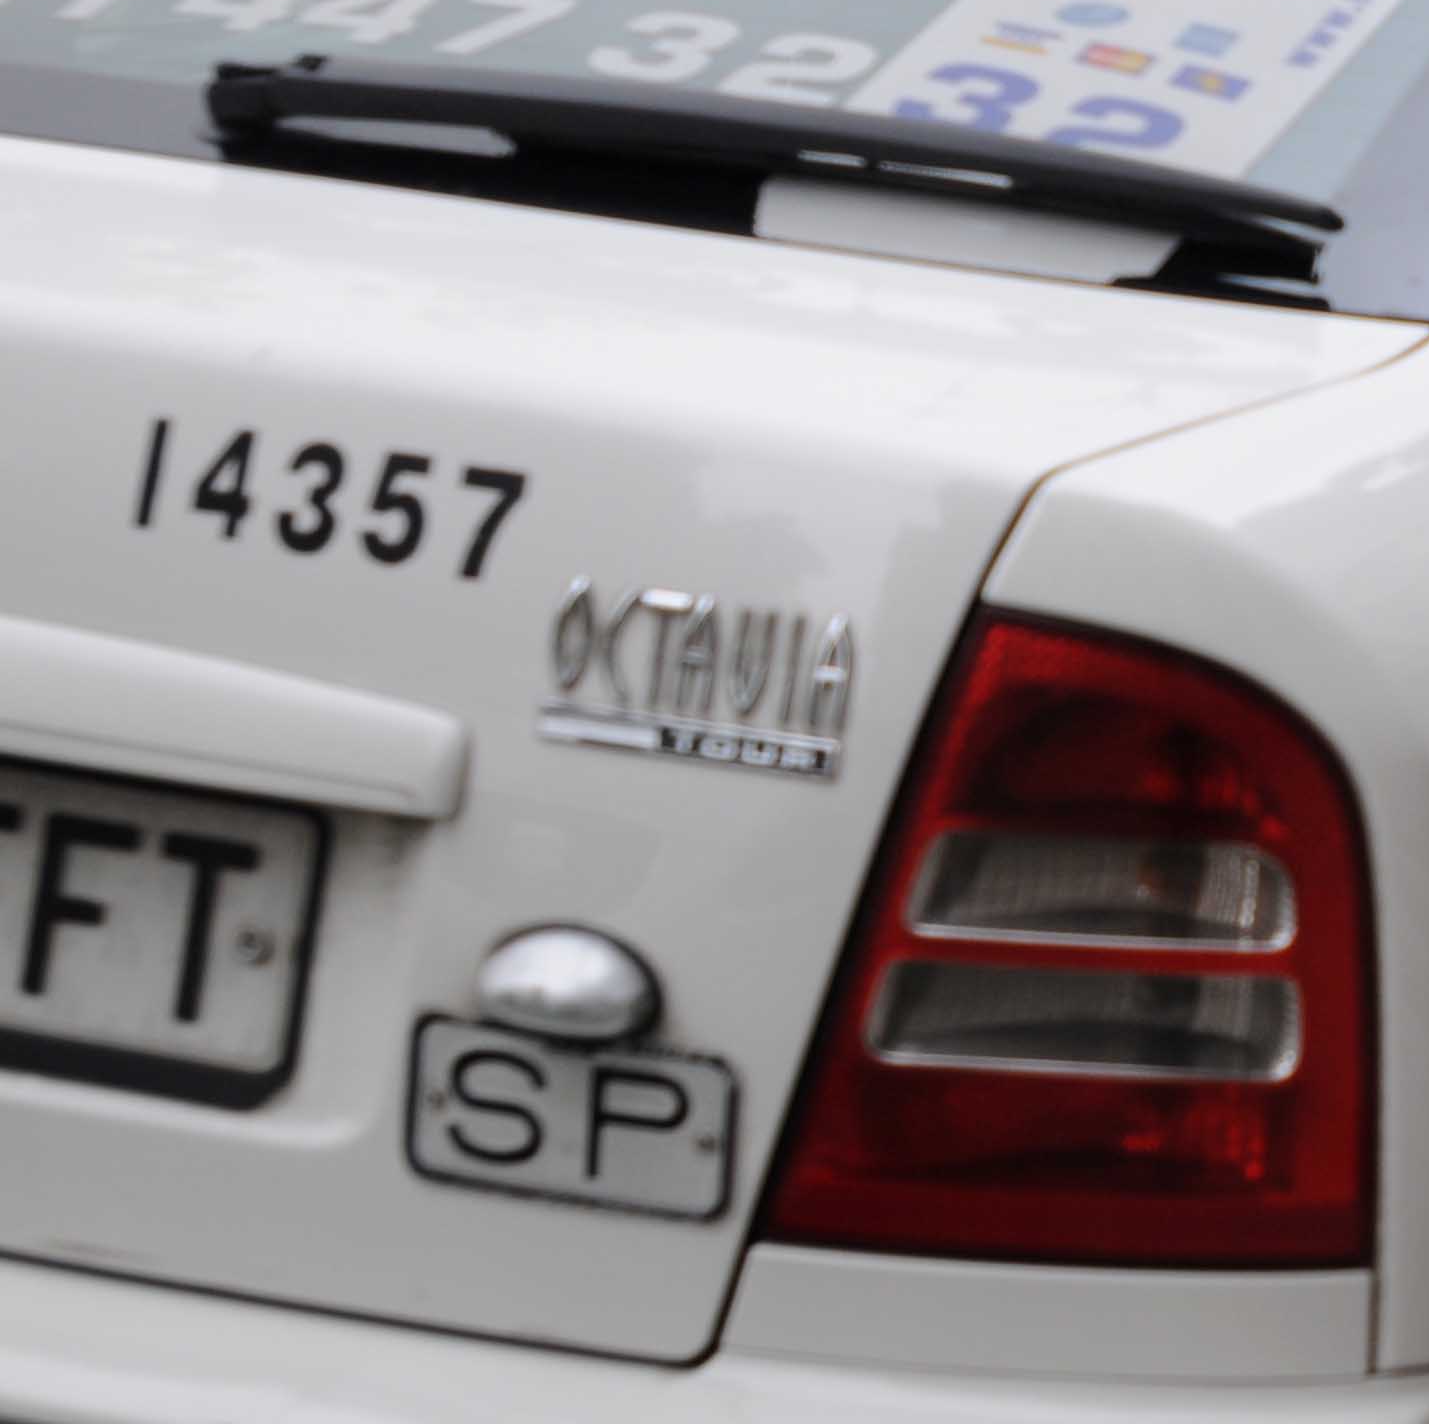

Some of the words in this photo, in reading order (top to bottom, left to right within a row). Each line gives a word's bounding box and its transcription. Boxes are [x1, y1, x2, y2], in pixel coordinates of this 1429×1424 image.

[588, 9, 880, 108] 32
[893, 62, 1188, 149] 32
[134, 418, 527, 581] 14357
[552, 574, 857, 734] OCTAVIA
[0, 806, 262, 1025] FT
[448, 1047, 690, 1179] SP
